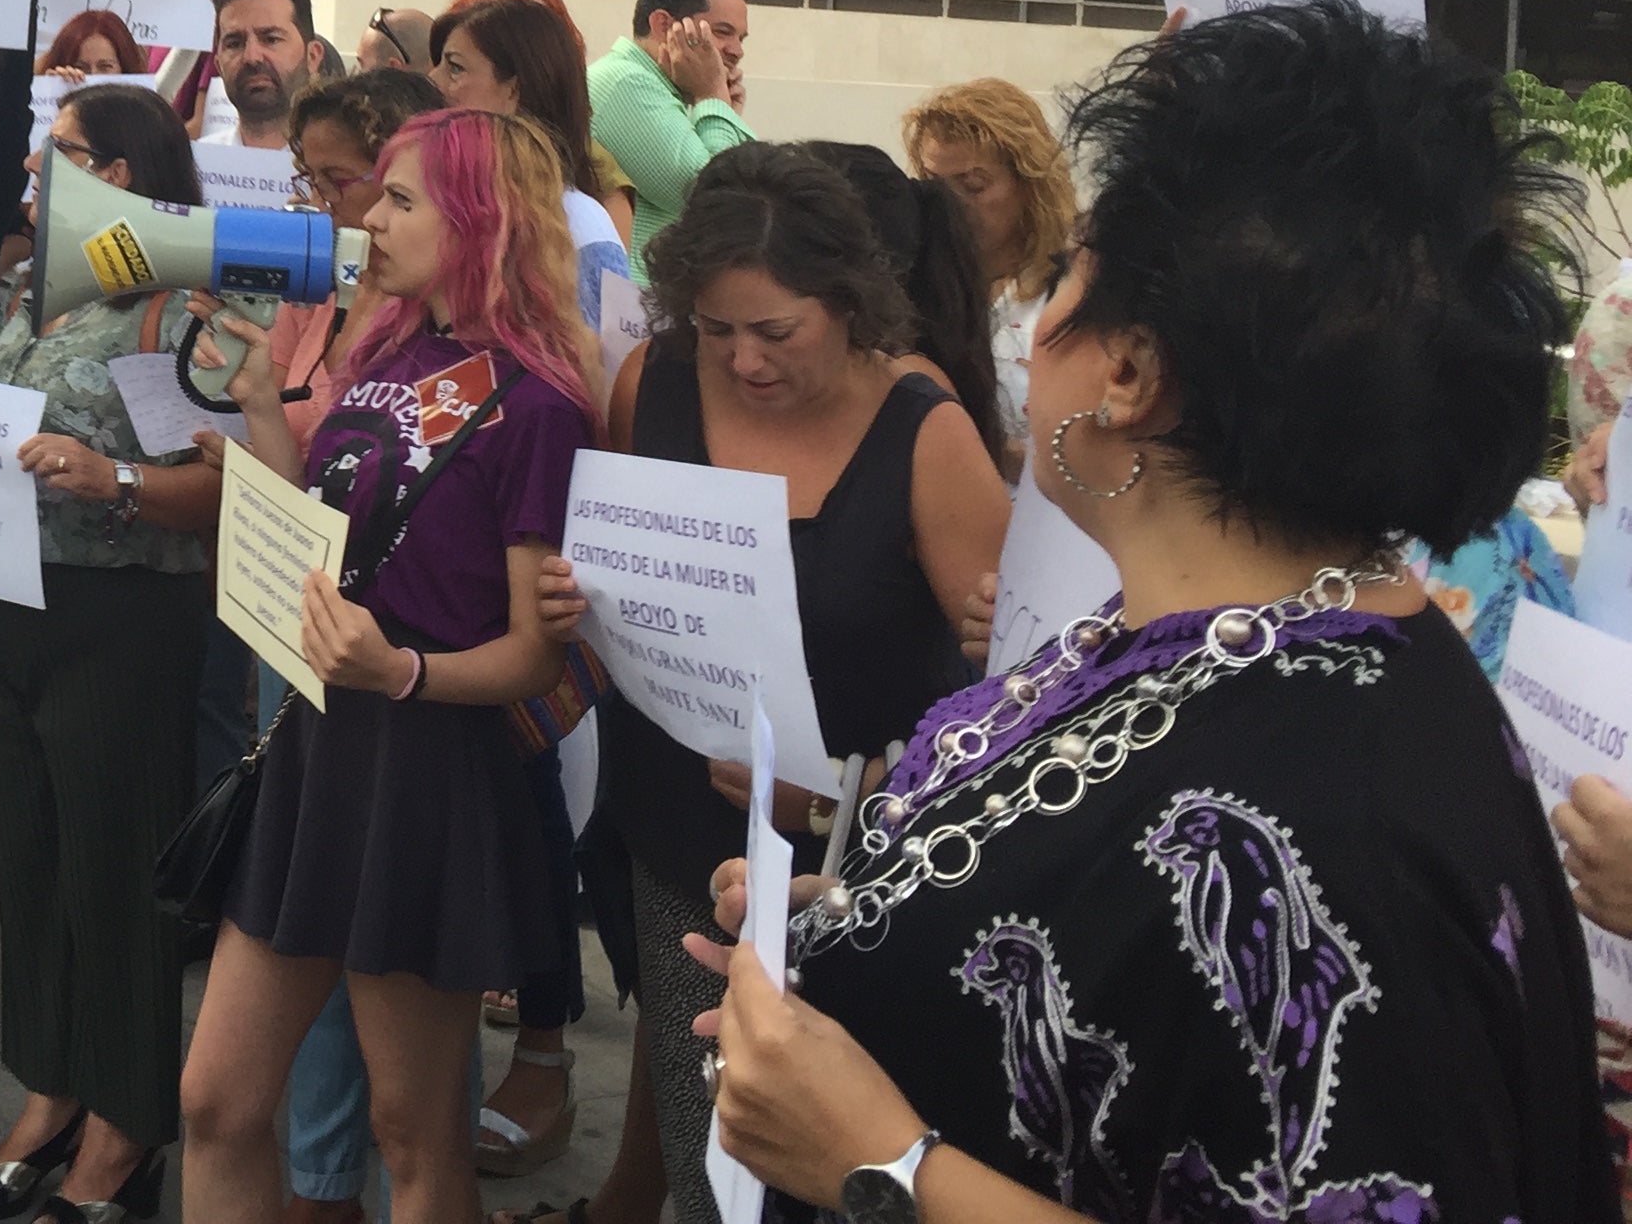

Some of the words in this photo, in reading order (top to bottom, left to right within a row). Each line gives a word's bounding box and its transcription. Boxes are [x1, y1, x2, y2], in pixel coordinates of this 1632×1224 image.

[259, 178, 276, 192] DE
[573, 498, 592, 518] LAS
[592, 501, 699, 539] PROFESIONALES
[702, 520, 723, 543] DE
[726, 525, 758, 549] LOS
[571, 542, 628, 572] CENTROS
[631, 554, 650, 575] DE
[654, 558, 672, 580] LA
[675, 562, 730, 593] MUJER
[734, 573, 757, 597] EN
[619, 598, 680, 636] APOYO
[684, 613, 707, 636] DE
[647, 646, 749, 692] GRANADOS
[696, 696, 745, 730] SANZ
[1599, 722, 1629, 761] LOS
